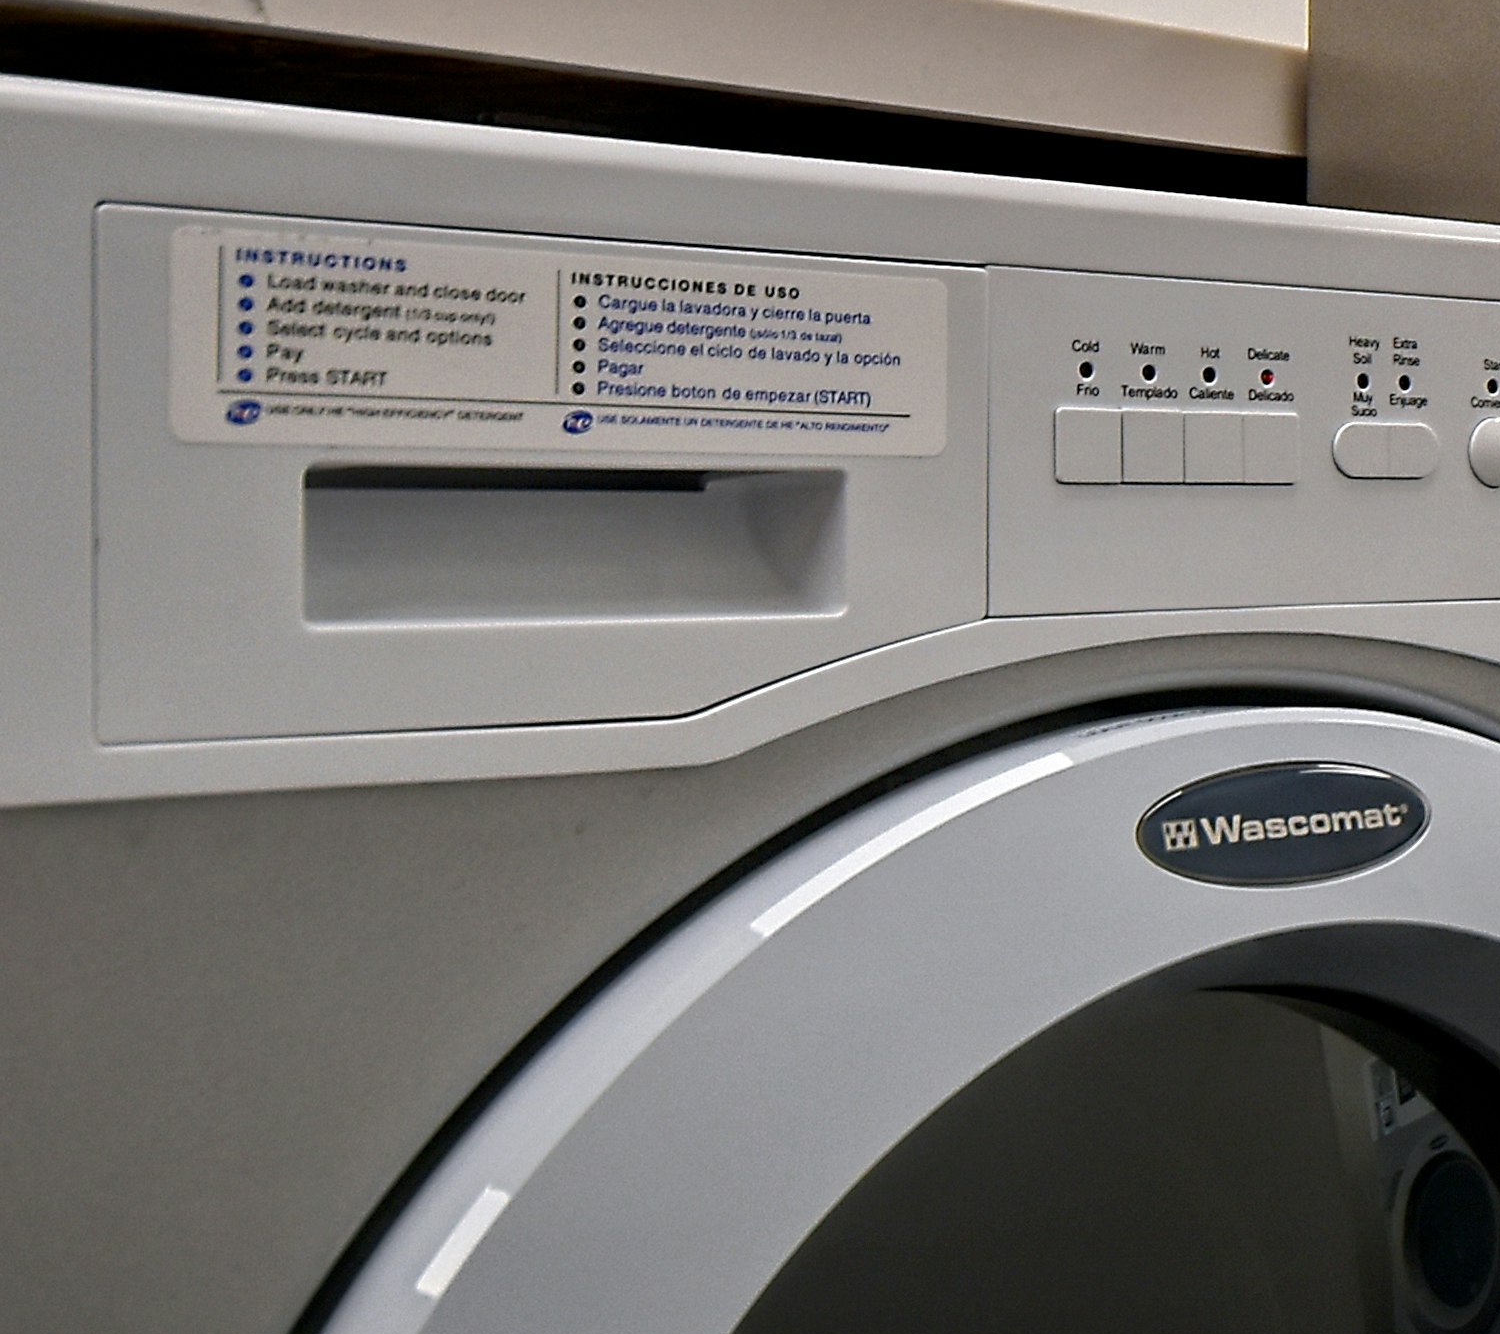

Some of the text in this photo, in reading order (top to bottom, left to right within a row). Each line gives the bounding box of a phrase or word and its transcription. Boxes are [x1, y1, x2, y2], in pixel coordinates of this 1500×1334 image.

[236, 248, 407, 273] INSTRUCTIONS
[267, 272, 525, 303] Load washer and close door
[571, 271, 801, 300] INSTRUCCIONES DE USO
[266, 296, 306, 314] Add
[312, 300, 401, 321] detergent
[598, 294, 872, 326] Cargue la lavadora y cierre la puerta
[267, 319, 492, 347] Select cycle and options
[597, 316, 664, 336] Agregue
[667, 320, 746, 341] detergente
[1071, 339, 1100, 353] Cold
[1129, 342, 1166, 355] Warm
[1348, 336, 1380, 351] Heavy
[1393, 336, 1418, 349] Extra
[266, 343, 304, 364] Pay
[598, 336, 901, 368] Seleccione el ciclo de lavado y la opción
[1200, 346, 1220, 359] Hot
[1247, 347, 1290, 362] Delicate
[1353, 352, 1373, 364] Soil
[1393, 353, 1420, 366] Rinse
[266, 367, 388, 387] Press START
[597, 358, 645, 378] Pagar
[597, 380, 667, 398] Presione
[722, 387, 741, 401] de
[745, 389, 811, 404] empezar
[814, 389, 872, 409] (START)
[1120, 384, 1179, 401] Templado
[1189, 386, 1235, 401] Caliente
[1248, 388, 1295, 402] Delicado
[1353, 391, 1373, 406] Muy
[1351, 405, 1378, 417] Sucio
[1200, 802, 1402, 846] Wascomat
